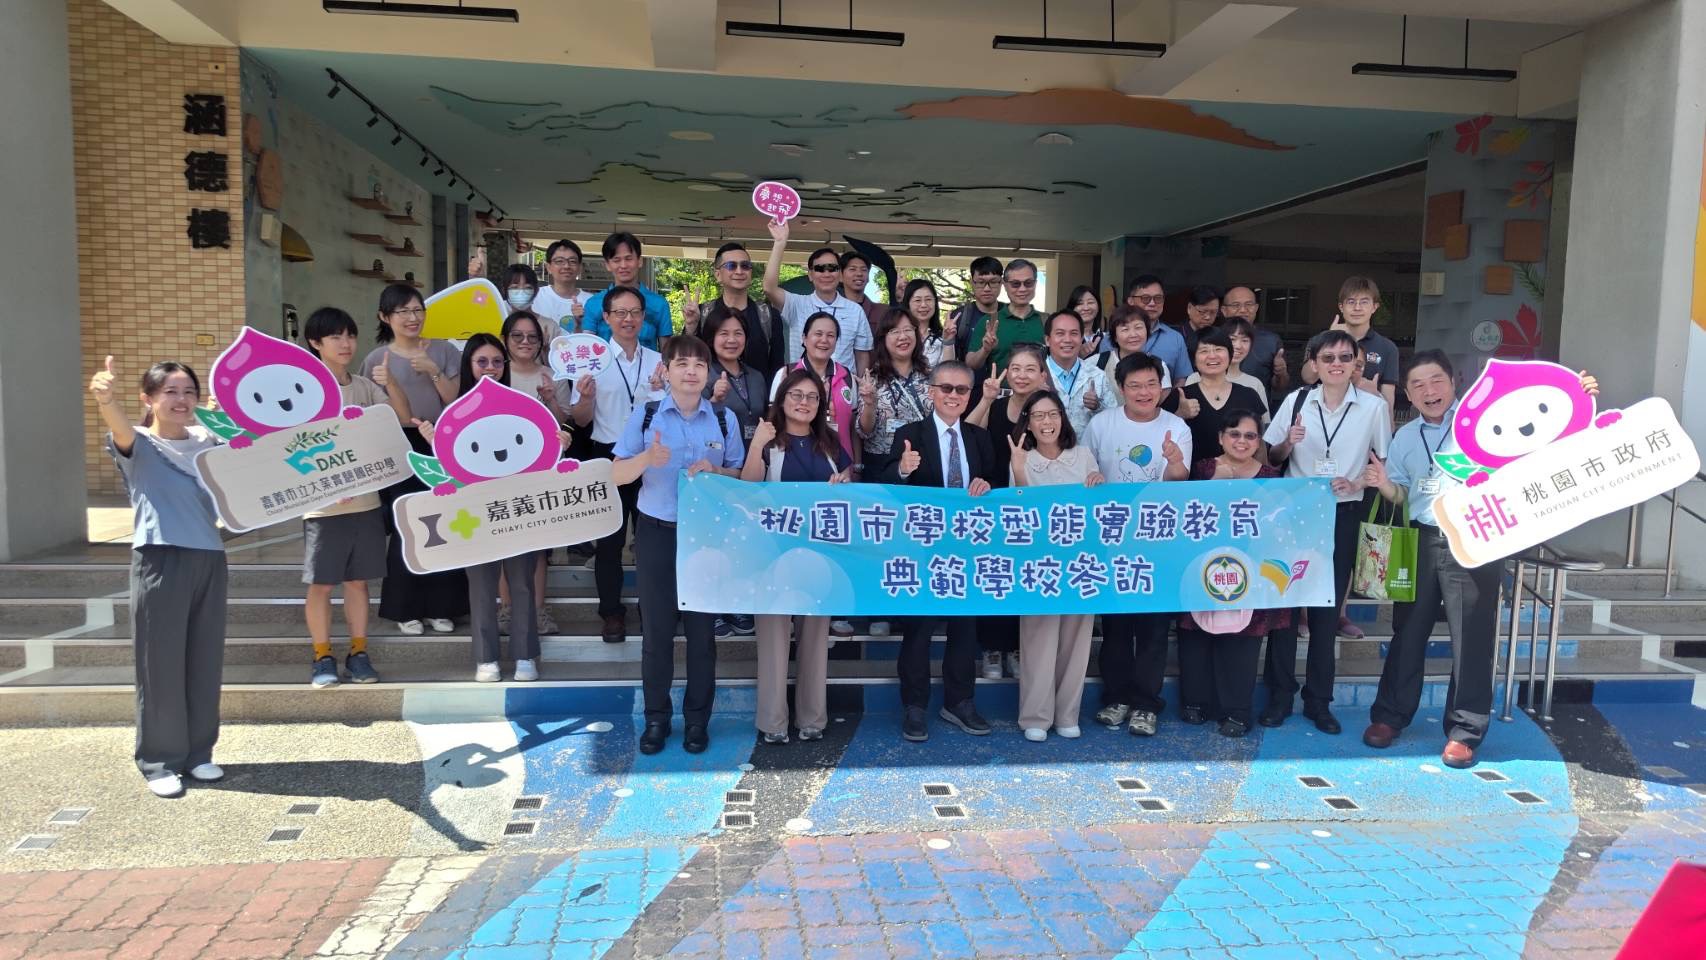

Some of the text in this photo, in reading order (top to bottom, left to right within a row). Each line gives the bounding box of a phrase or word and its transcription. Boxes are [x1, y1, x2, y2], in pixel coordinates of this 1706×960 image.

[182, 94, 231, 249] 涵德樓
[759, 186, 783, 203] 夢想
[560, 344, 591, 363] 快樂
[566, 358, 601, 374] 每一天
[315, 449, 358, 472] DAYE
[383, 469, 399, 478] School
[1522, 427, 1673, 505] 桃園市政府
[1533, 452, 1683, 519] TAOYUAN CITY GOVERNMENT
[485, 480, 609, 523] 嘉義市政府
[491, 505, 613, 536] CHIAYI CITY GOVERNMENT
[759, 500, 1261, 545] 桃園市學校型態實驗教育
[882, 552, 1153, 598] 典範學校參訪
[1213, 571, 1239, 586] 桃園
